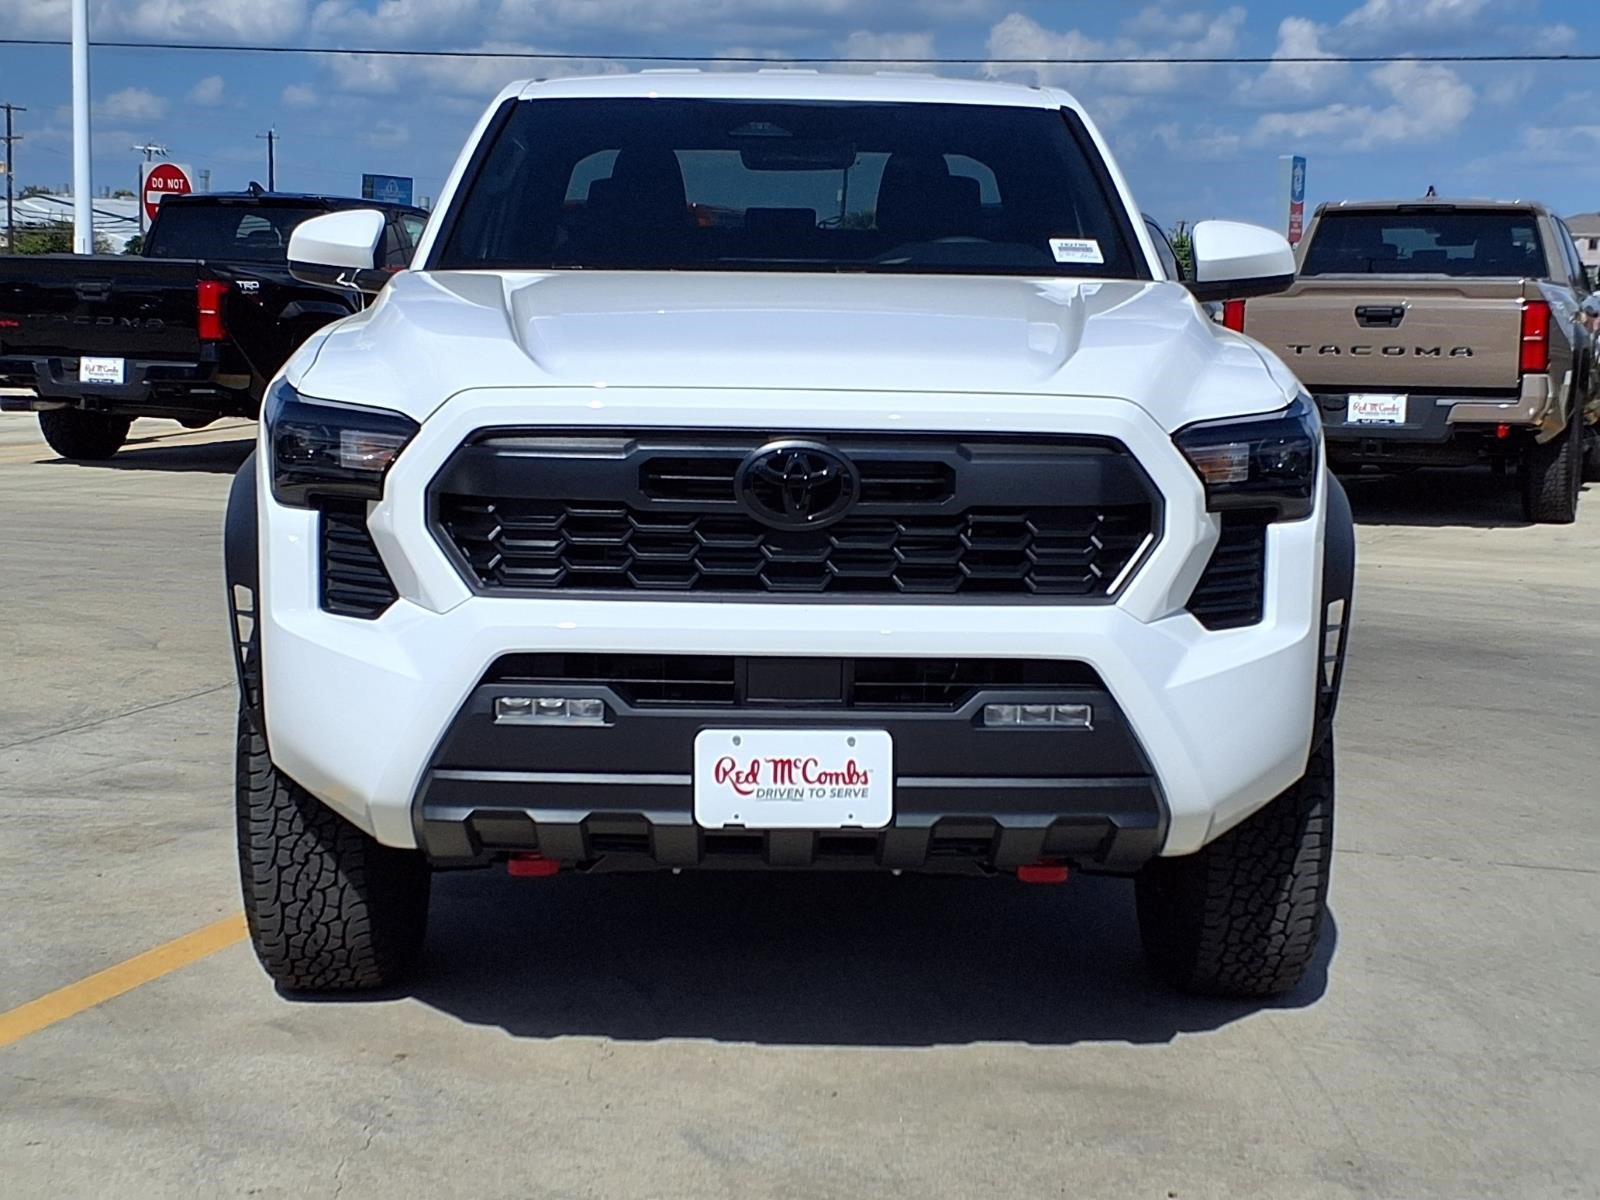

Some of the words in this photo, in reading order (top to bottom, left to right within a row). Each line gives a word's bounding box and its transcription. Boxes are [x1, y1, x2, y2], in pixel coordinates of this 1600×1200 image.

[151, 176, 164, 189] DO
[167, 178, 185, 190] NOT
[235, 280, 260, 290] TRD
[1286, 344, 1474, 357] TACOMA
[714, 756, 760, 796] Red
[756, 787, 805, 799] DRIVEN
[809, 787, 826, 799] TO
[830, 787, 869, 799] SERVE
